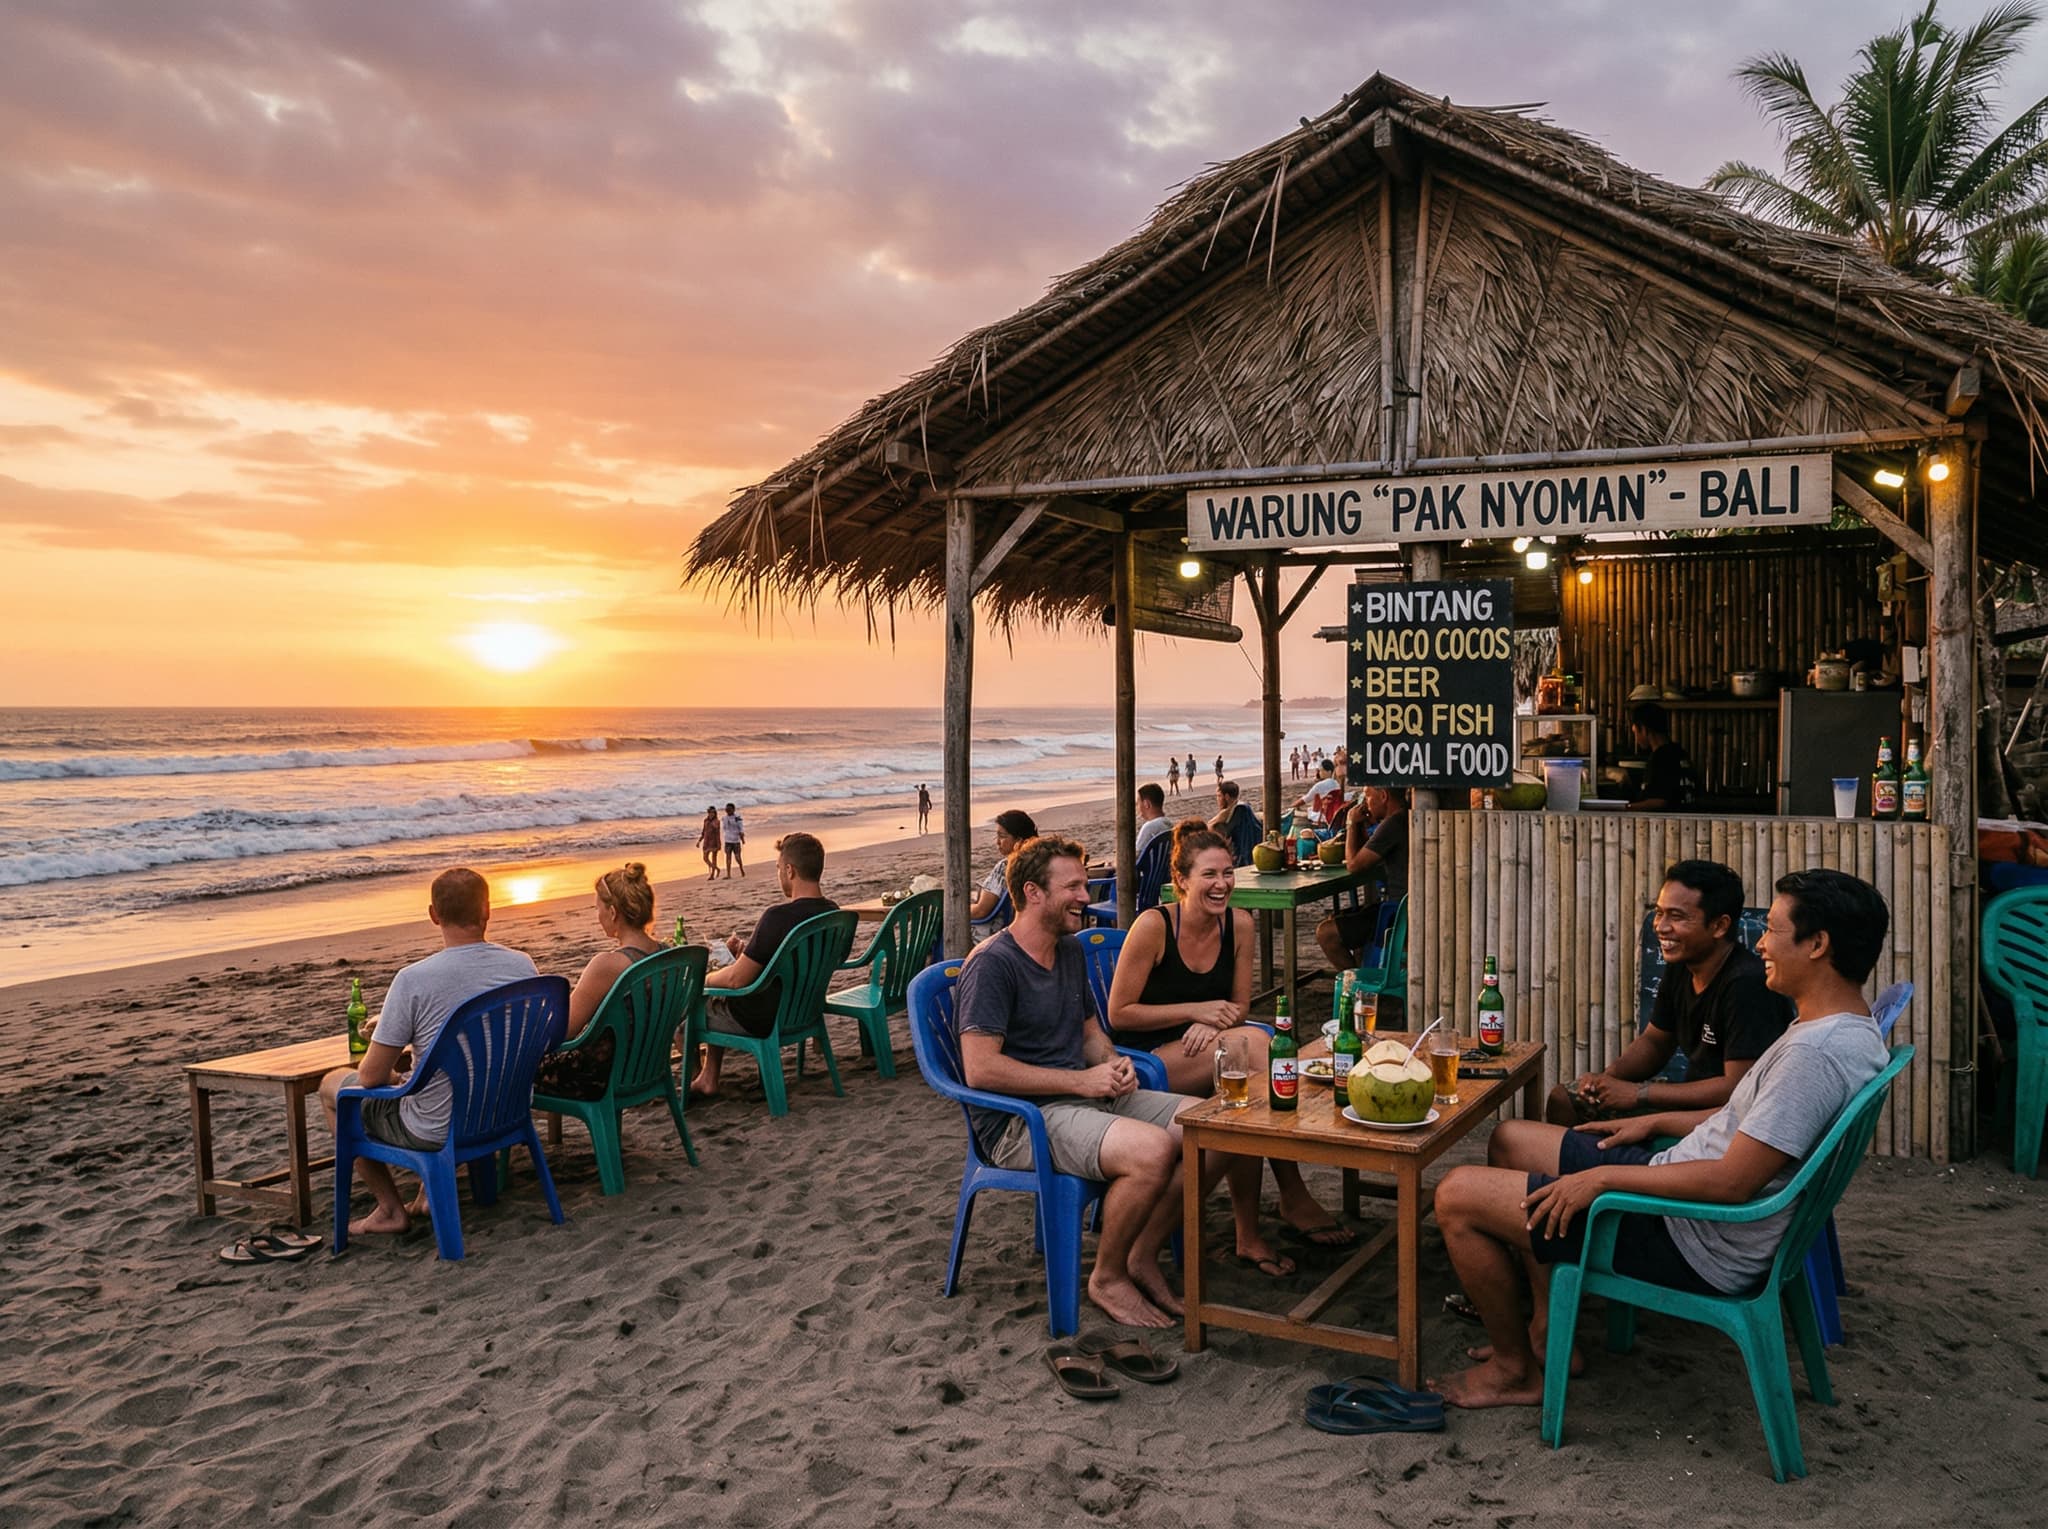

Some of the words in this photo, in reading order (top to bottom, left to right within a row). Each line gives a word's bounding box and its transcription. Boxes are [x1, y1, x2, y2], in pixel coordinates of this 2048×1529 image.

[1206, 490, 1362, 540] WARUNG
[1373, 484, 1466, 532] “PAK
[1481, 469, 1667, 529] NYOMAN”
[1699, 465, 1800, 518] BALI
[1366, 628, 1430, 661] NACO
[1434, 626, 1510, 660] COCOS
[1366, 666, 1440, 698] BEER
[1366, 703, 1424, 737] BBQ
[1432, 703, 1494, 736] FISH
[1366, 741, 1440, 775] LOCAL
[1446, 742, 1509, 777] FOOD
